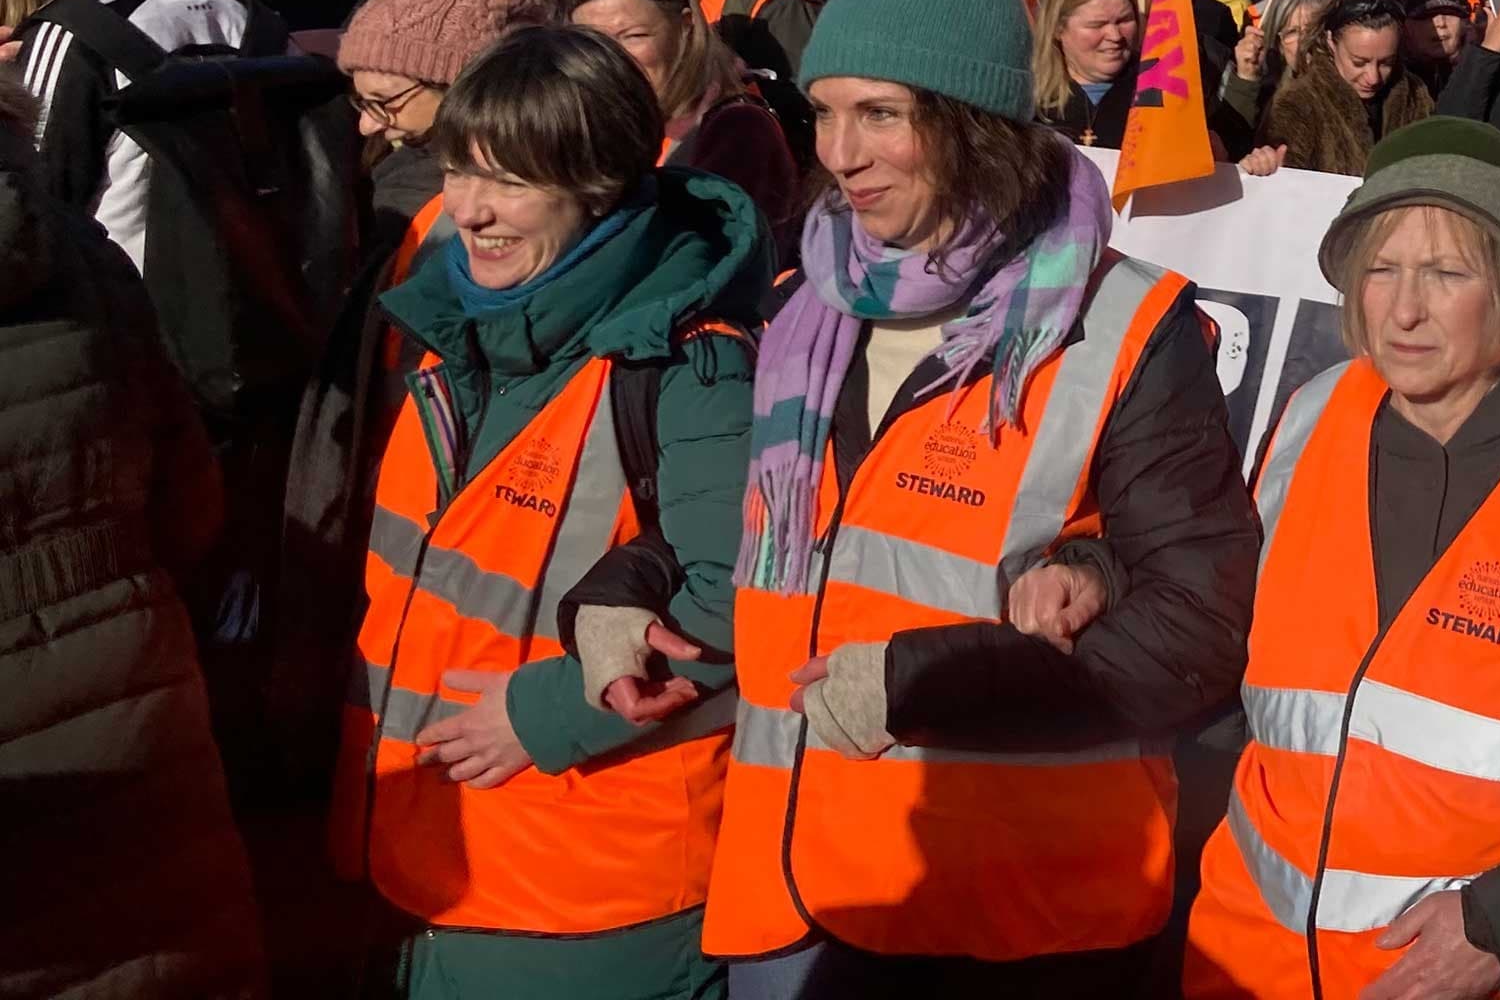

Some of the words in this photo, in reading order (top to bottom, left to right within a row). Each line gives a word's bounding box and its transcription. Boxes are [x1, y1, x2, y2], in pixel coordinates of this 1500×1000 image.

[924, 441, 976, 460] education
[494, 485, 557, 518] TEWARD
[895, 472, 986, 507] STEWARD
